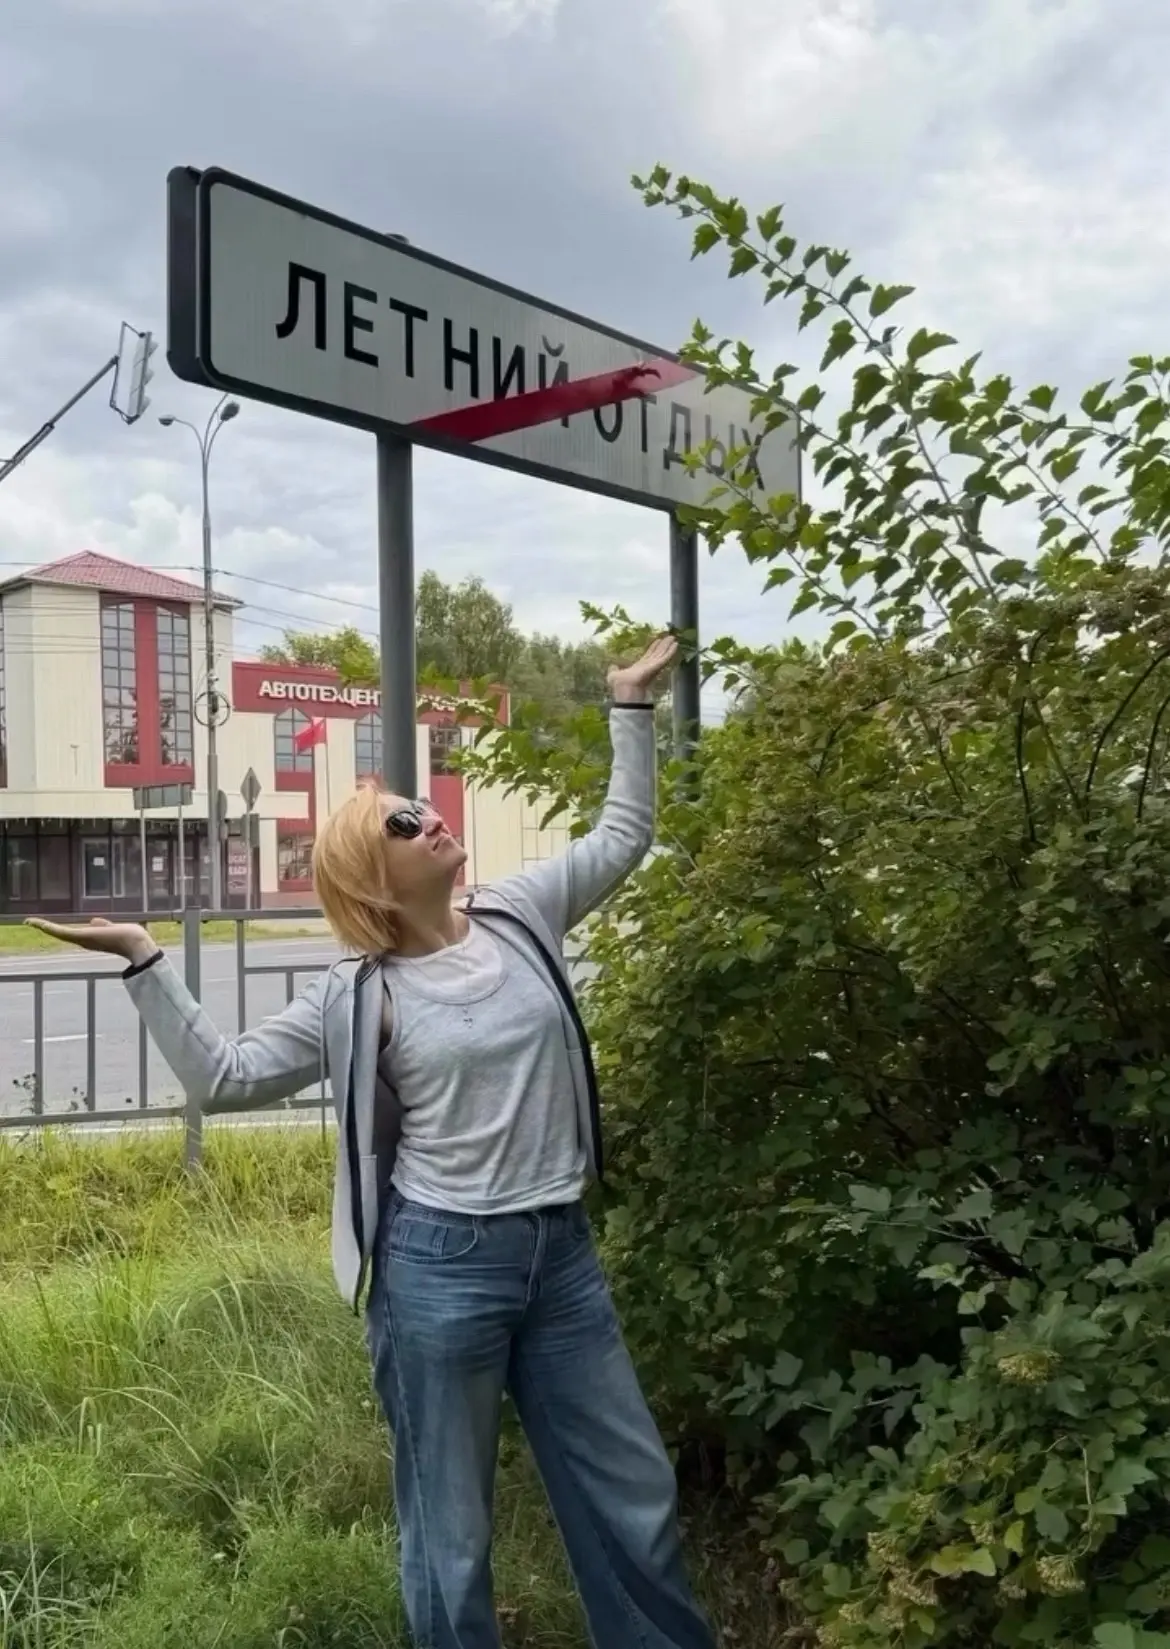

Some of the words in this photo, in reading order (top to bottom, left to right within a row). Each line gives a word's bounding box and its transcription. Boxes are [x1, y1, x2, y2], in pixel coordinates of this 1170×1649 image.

[275, 261, 569, 429] ЛЕТНИЙ
[593, 385, 765, 491] ОТДЫХ
[259, 680, 382, 707] АВТОТЕХЦЕН
